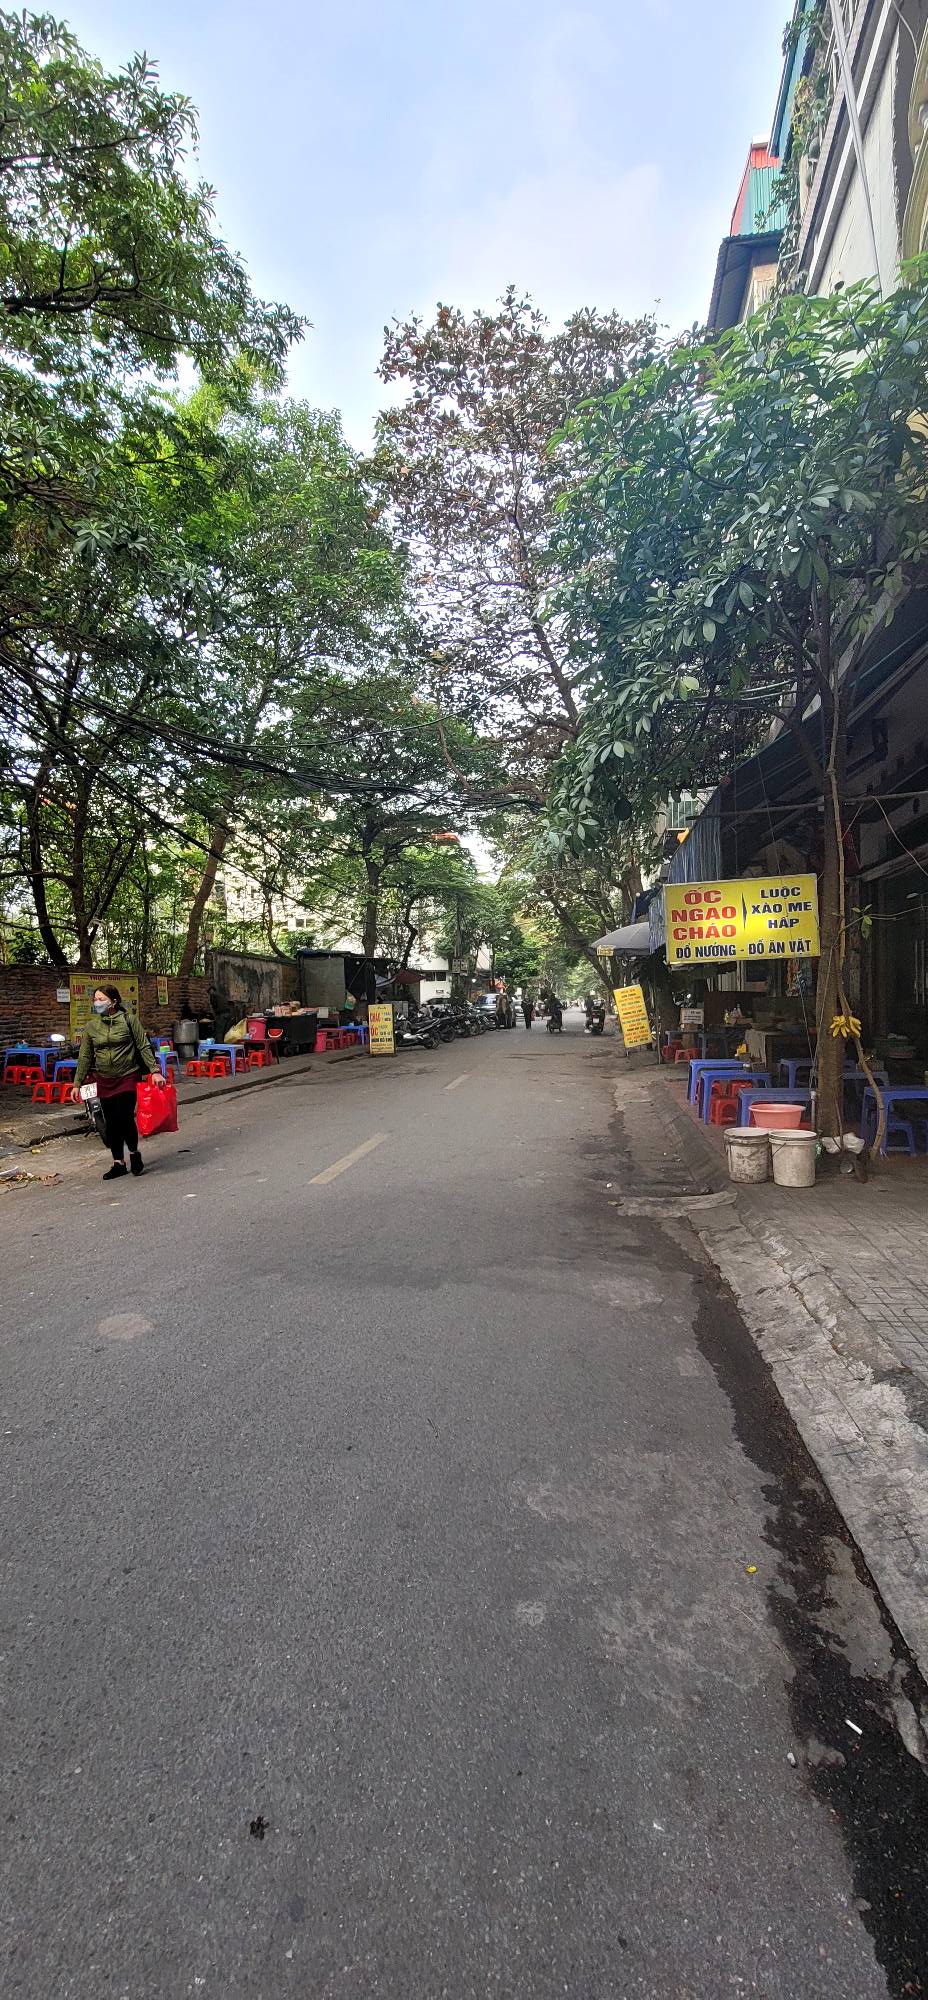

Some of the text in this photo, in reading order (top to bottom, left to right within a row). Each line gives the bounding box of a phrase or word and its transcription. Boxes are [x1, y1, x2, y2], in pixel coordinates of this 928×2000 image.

[684, 887, 722, 904] ỐC
[760, 886, 801, 900] LUỘC
[671, 906, 737, 923] NGAO
[751, 901, 813, 915] XÀO ME
[768, 916, 800, 929] HẤP
[673, 923, 737, 941] CHÁO
[695, 942, 737, 958] NƯỚNG
[768, 939, 785, 954] ĂN
[788, 938, 812, 955] VẶT
